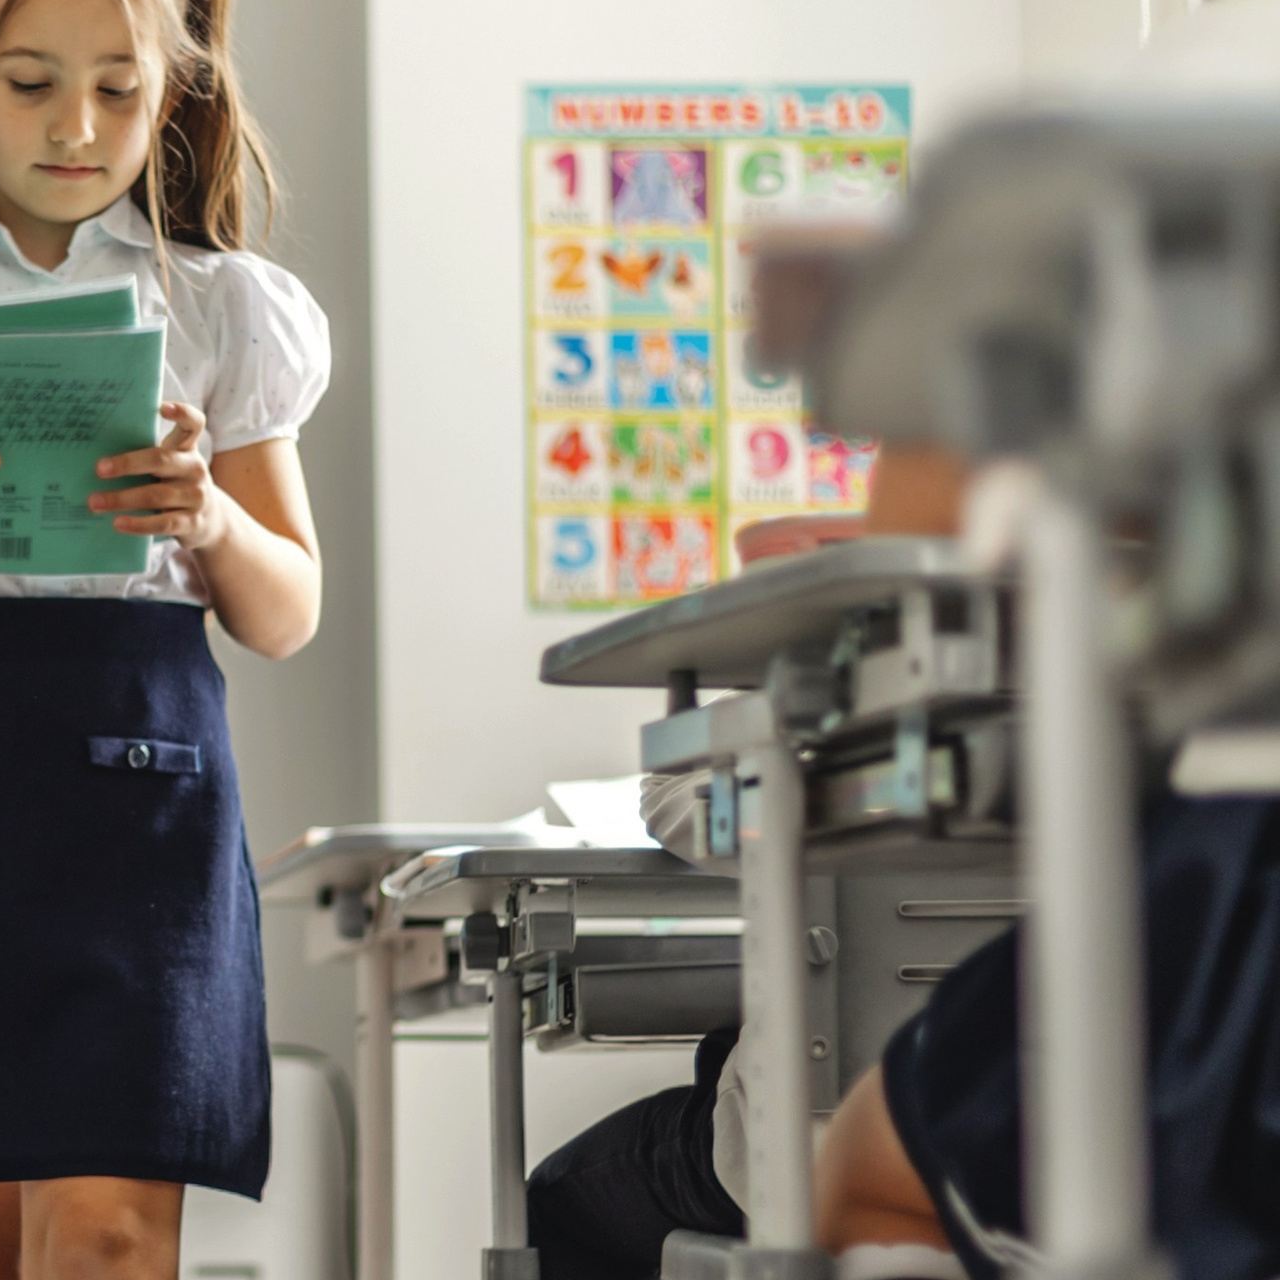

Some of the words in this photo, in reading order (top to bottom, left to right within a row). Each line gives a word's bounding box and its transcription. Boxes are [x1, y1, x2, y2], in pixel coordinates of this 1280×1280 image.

[554, 96, 763, 130] NUMBERS
[551, 150, 578, 199] 1
[739, 150, 786, 197] 6
[548, 245, 587, 293] 2
[552, 334, 594, 386] 3
[548, 428, 591, 478] 4
[747, 429, 790, 480] 9
[553, 521, 596, 570] 5
